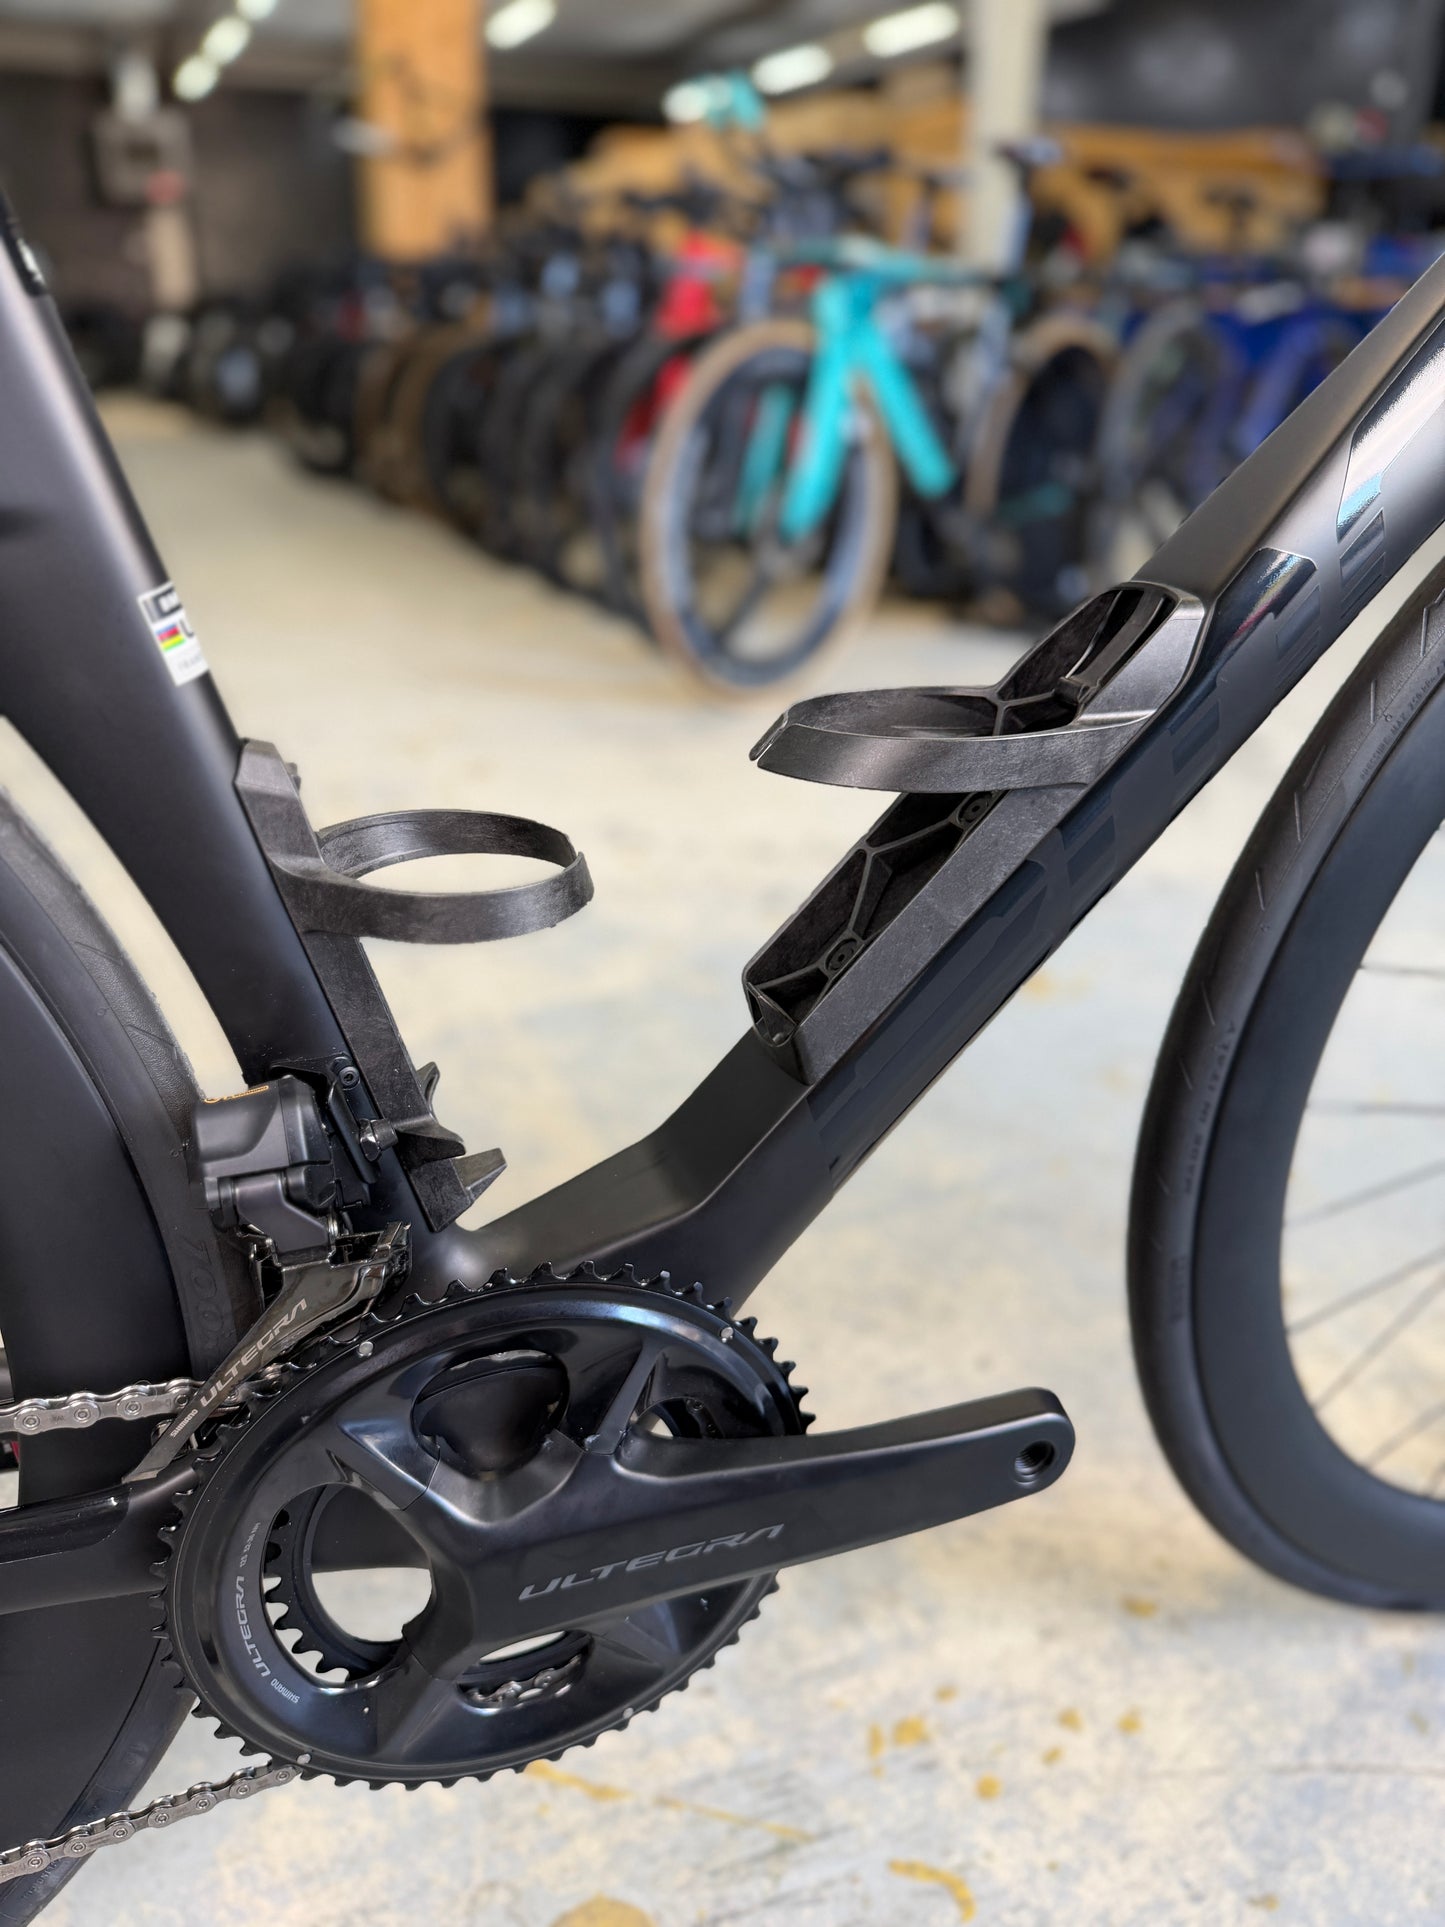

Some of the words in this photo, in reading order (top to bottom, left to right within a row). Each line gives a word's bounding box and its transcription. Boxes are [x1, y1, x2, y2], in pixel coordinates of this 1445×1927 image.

[170, 1408, 199, 1438] SHIMANO
[199, 1298, 308, 1408] ULTEGRA
[518, 1523, 785, 1602] ULTEGRA
[235, 1575, 271, 1678] ULTEGRA
[270, 1677, 301, 1705] SHIMANO
